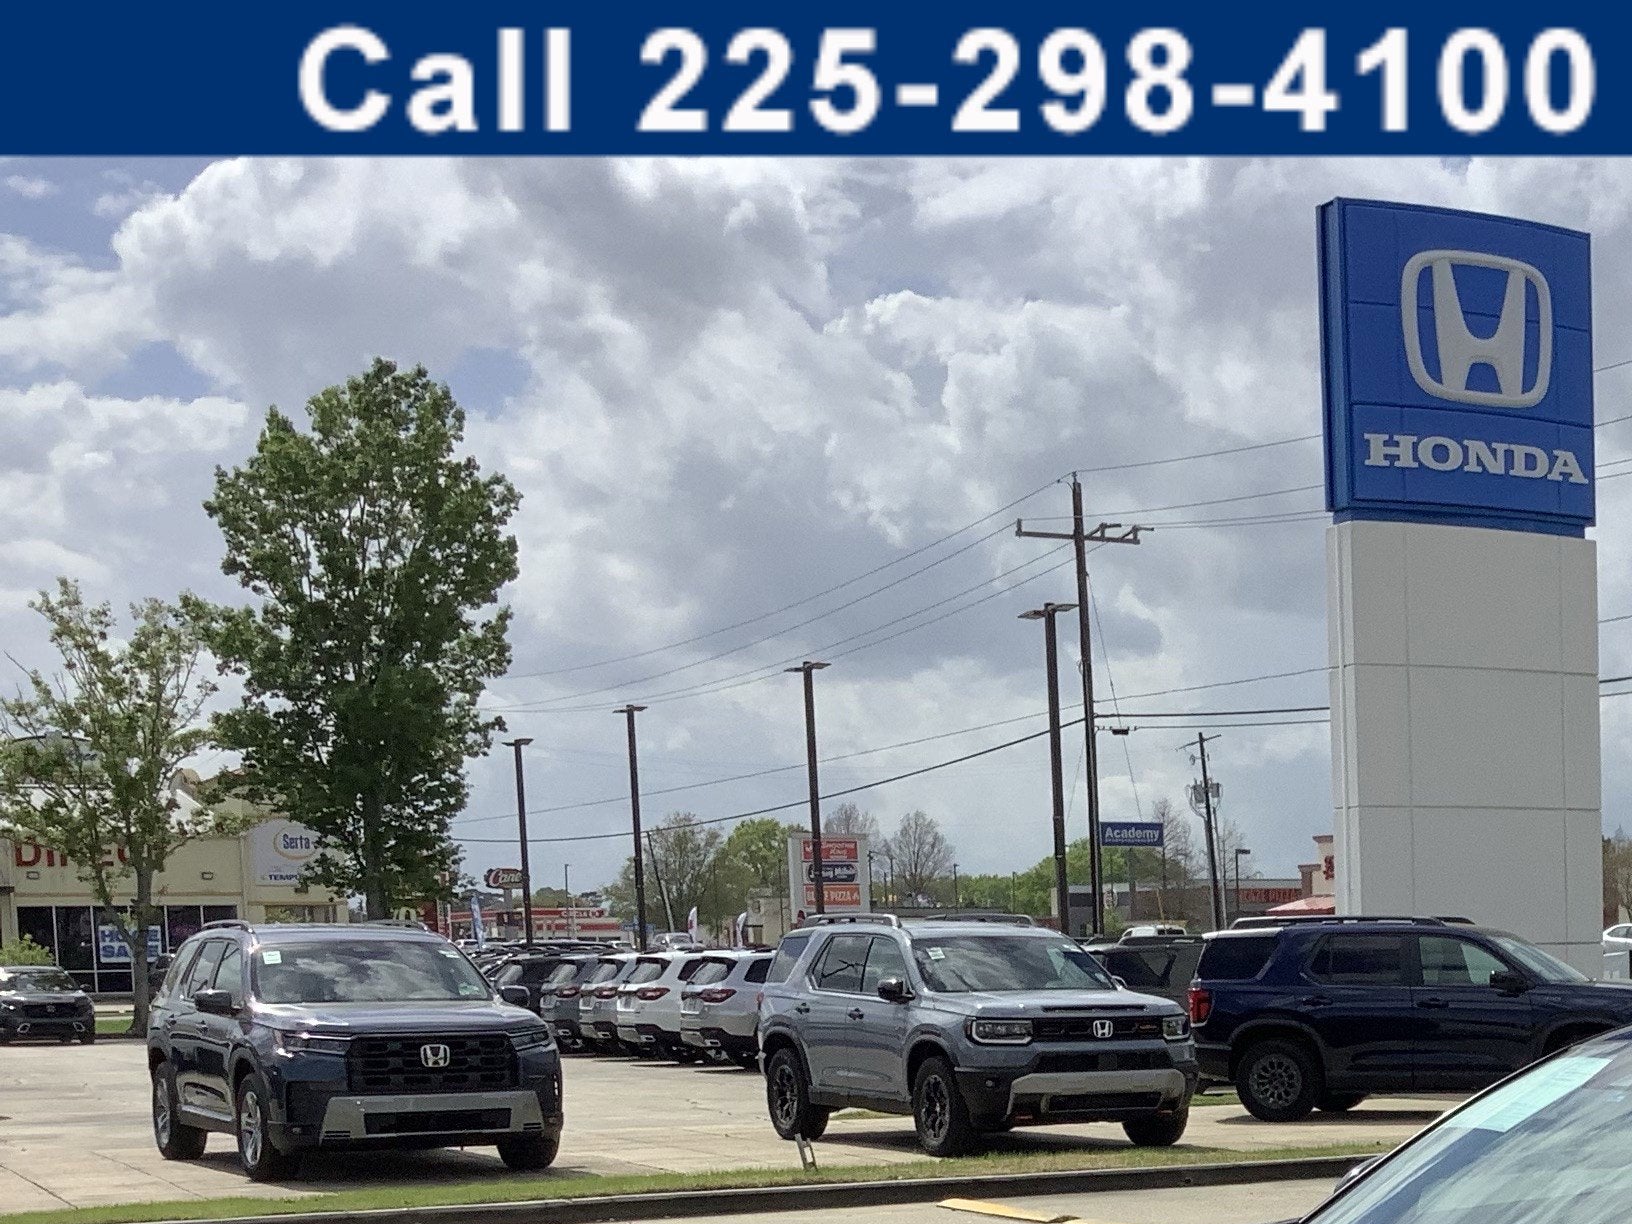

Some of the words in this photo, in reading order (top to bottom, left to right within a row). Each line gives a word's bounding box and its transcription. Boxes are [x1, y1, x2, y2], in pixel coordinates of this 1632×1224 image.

[1364, 433, 1589, 485] HONDA
[282, 834, 311, 850] Serta
[1105, 826, 1160, 842] Academy
